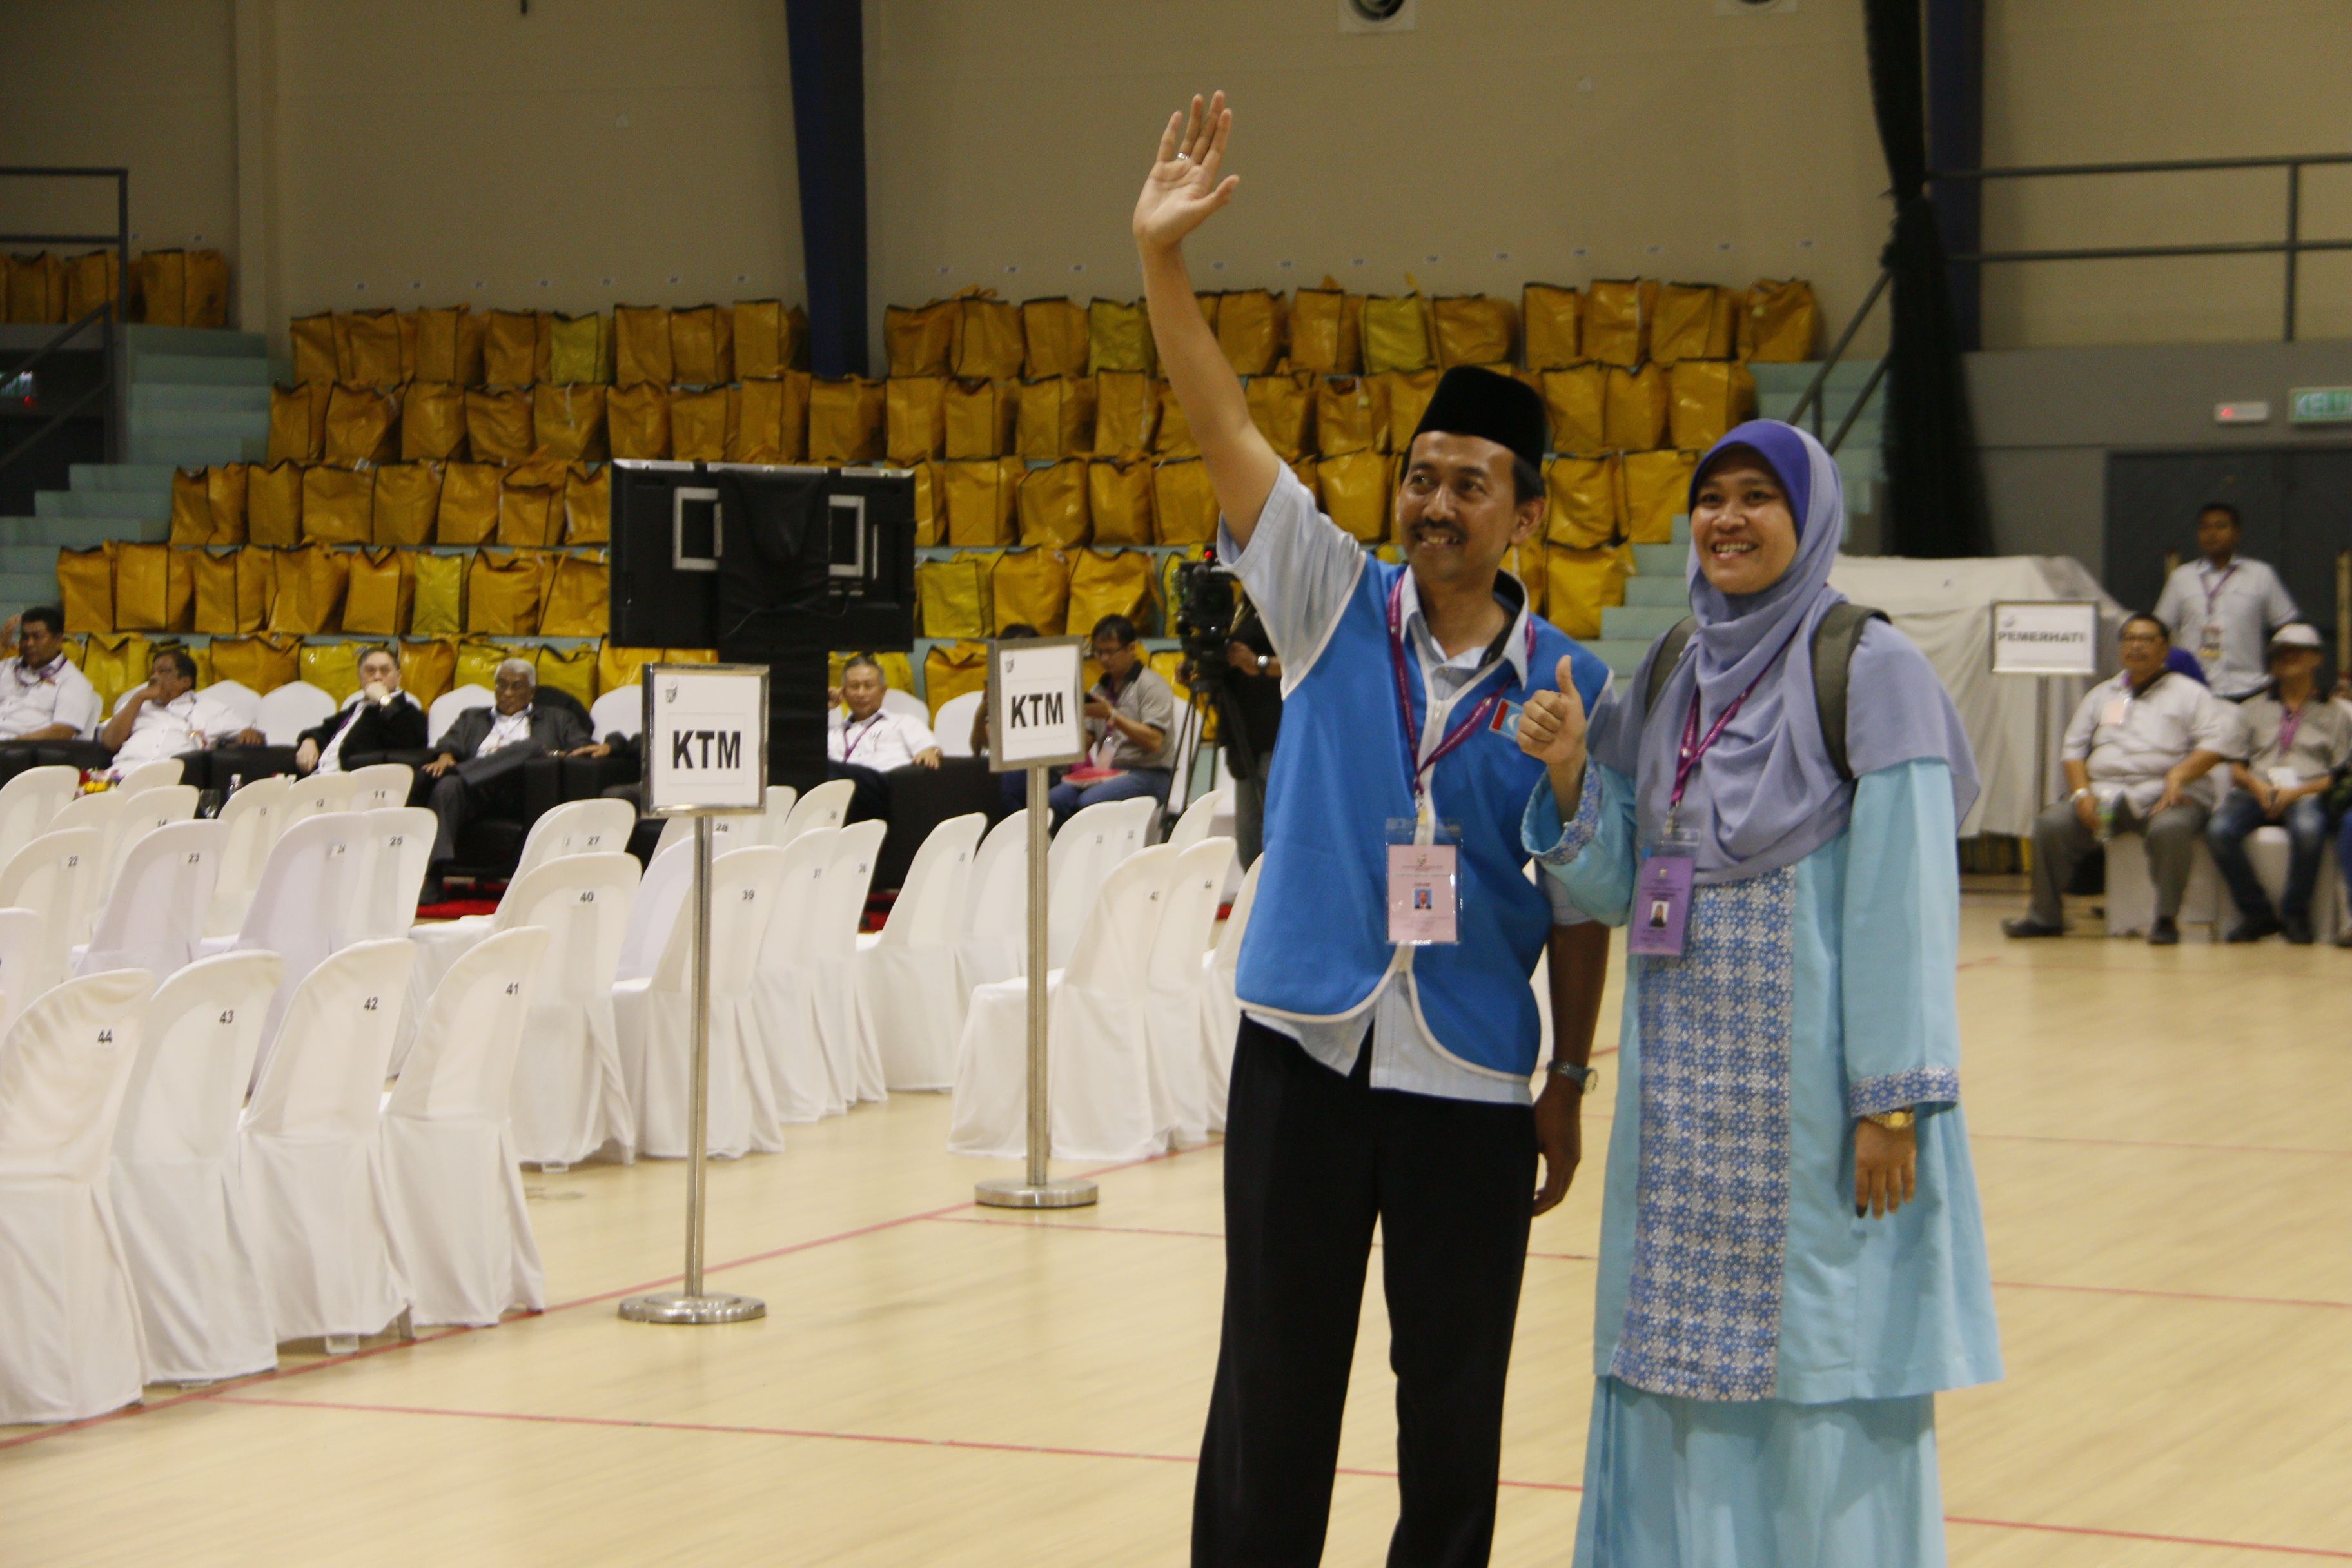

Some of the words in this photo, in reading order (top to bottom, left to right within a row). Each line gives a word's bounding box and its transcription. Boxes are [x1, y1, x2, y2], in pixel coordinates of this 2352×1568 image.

[1998, 631, 2084, 642] PEMERHATI
[1010, 692, 1064, 728] KTM
[672, 730, 741, 769] KTM
[374, 790, 386, 799] 11
[587, 835, 600, 846] 27
[68, 855, 78, 867] 22
[188, 852, 200, 863] 23
[580, 890, 594, 903] 40
[505, 982, 519, 995] 41
[364, 996, 378, 1011] 42
[219, 1009, 234, 1024] 43
[97, 1028, 113, 1044] 44
